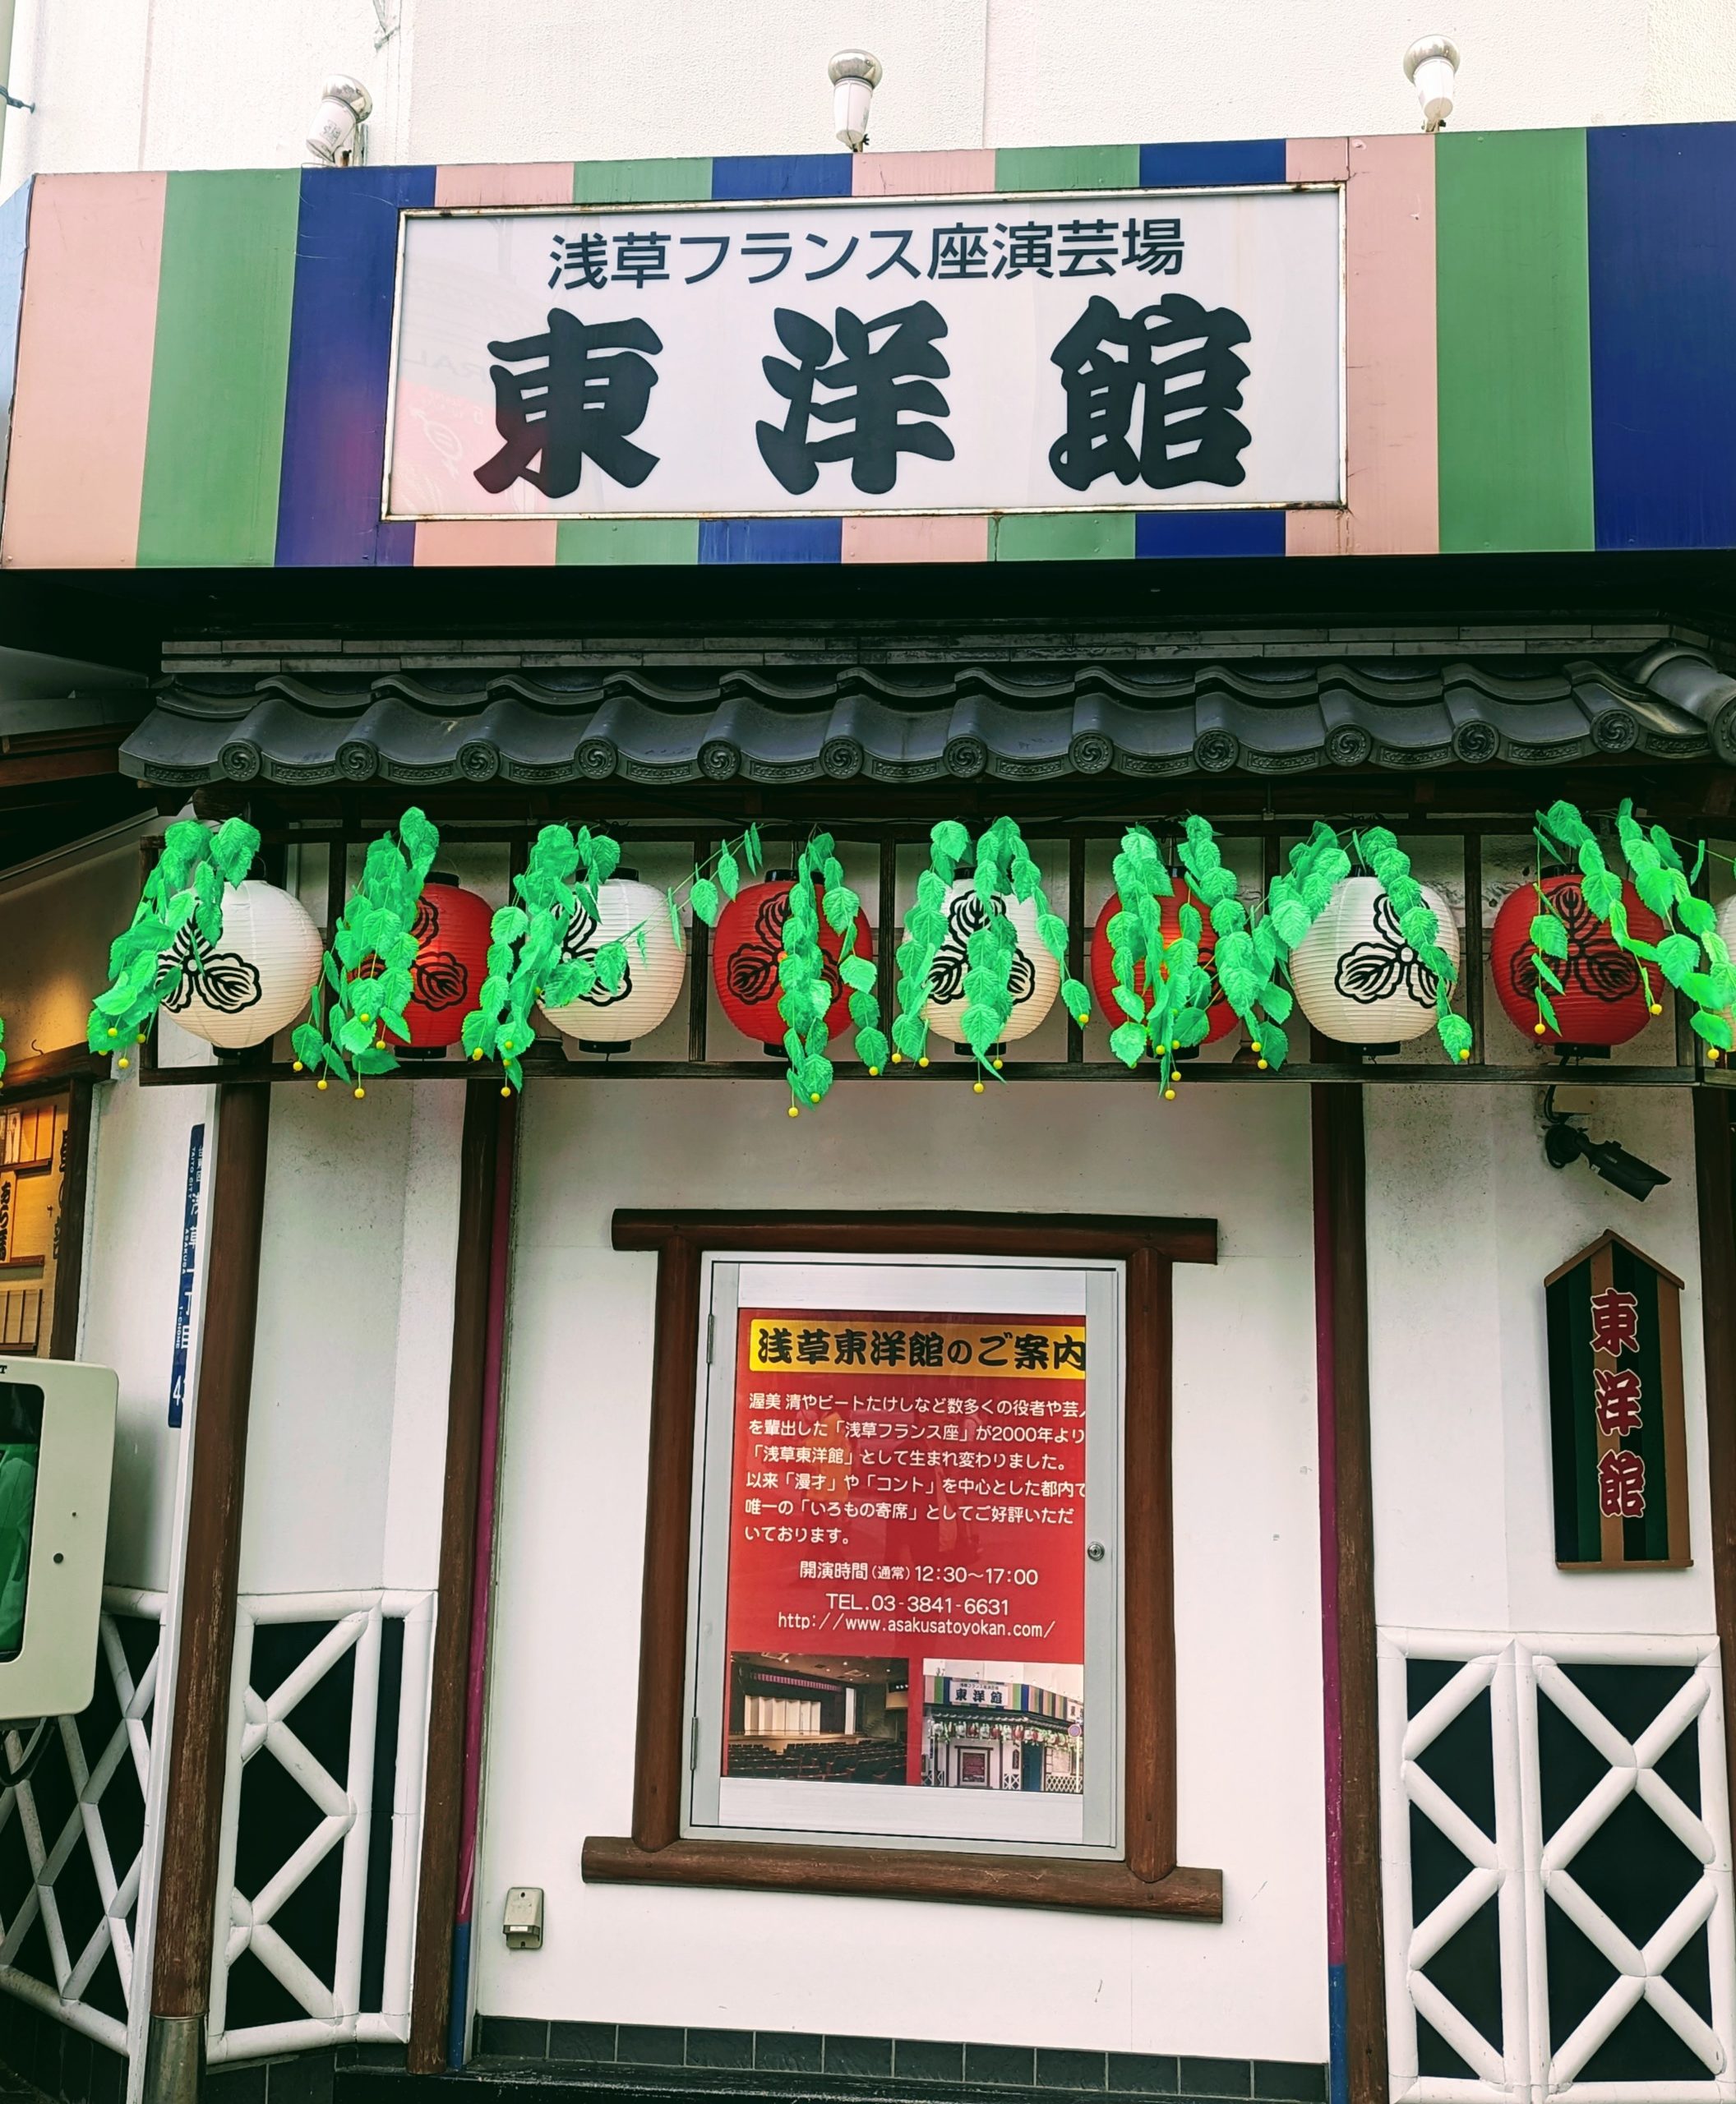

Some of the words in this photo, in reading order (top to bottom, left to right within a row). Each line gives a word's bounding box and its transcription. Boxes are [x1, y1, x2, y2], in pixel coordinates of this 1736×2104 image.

[547, 218, 1185, 290] 浅草フランス座演芸場
[473, 292, 1254, 499] 東洋館
[182, 1228, 190, 1275] ASAKUSA
[757, 1327, 1086, 1372] 浅草東洋館のご案内
[785, 1393, 1086, 1419] 清やビートたけしなど数多くの役者や芸
[1590, 1288, 1646, 1518] 東洋館
[749, 1419, 1085, 1444] を輩出した「浅草フランス座」が2000年より
[754, 1444, 1065, 1471] 「浅草東洋館」として生まれ変わりました。
[745, 1498, 1074, 1525] 唯一の「いろもの寄席」としてご好評いただ
[745, 1525, 849, 1545] いております。
[778, 1612, 1056, 1639] http://www.asakusatoyokan.com/
